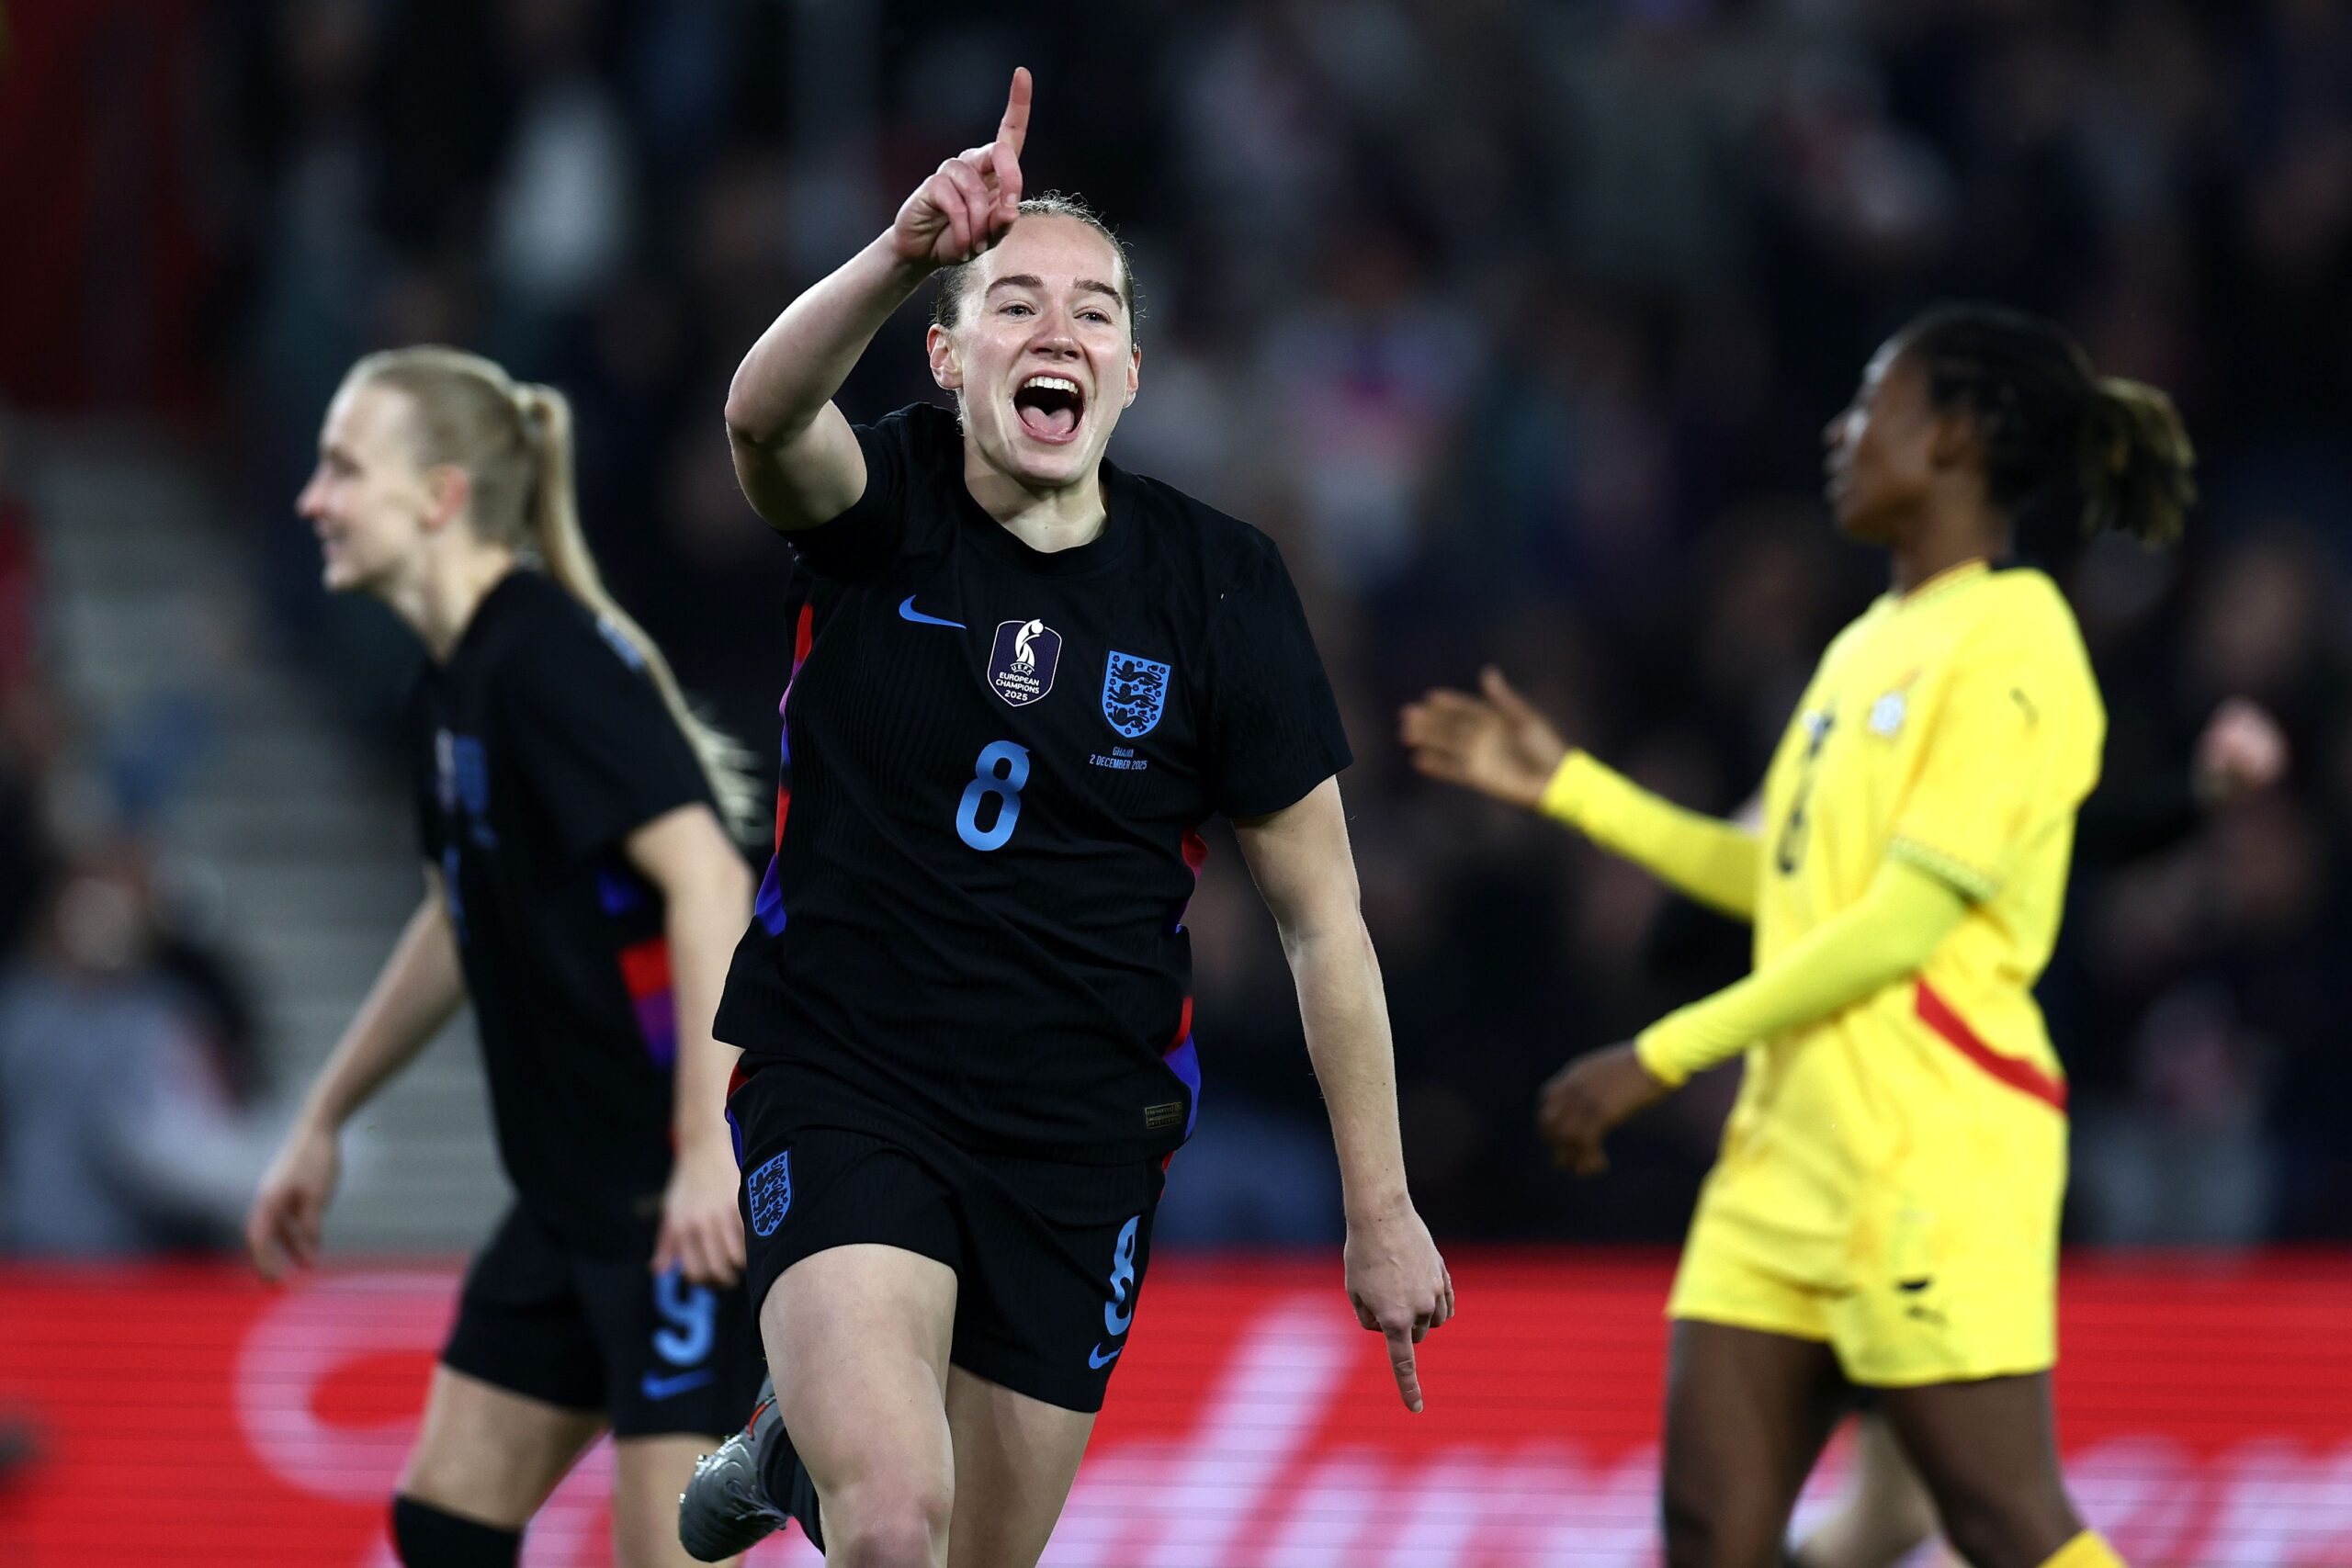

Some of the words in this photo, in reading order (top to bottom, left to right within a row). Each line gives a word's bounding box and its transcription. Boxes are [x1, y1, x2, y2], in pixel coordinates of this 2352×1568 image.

[1011, 664, 1033, 675] UEFA
[999, 671, 1039, 686] EUROPEAN
[995, 679, 1039, 694] CHAMPIONS
[1004, 689, 1028, 701] 2025
[1089, 754, 1096, 764] 2
[1096, 755, 1131, 770] DECEMBER
[1131, 760, 1148, 770] 2025
[956, 740, 1030, 852] 8
[1104, 1215, 1141, 1336] 8
[652, 1258, 716, 1366] 9
